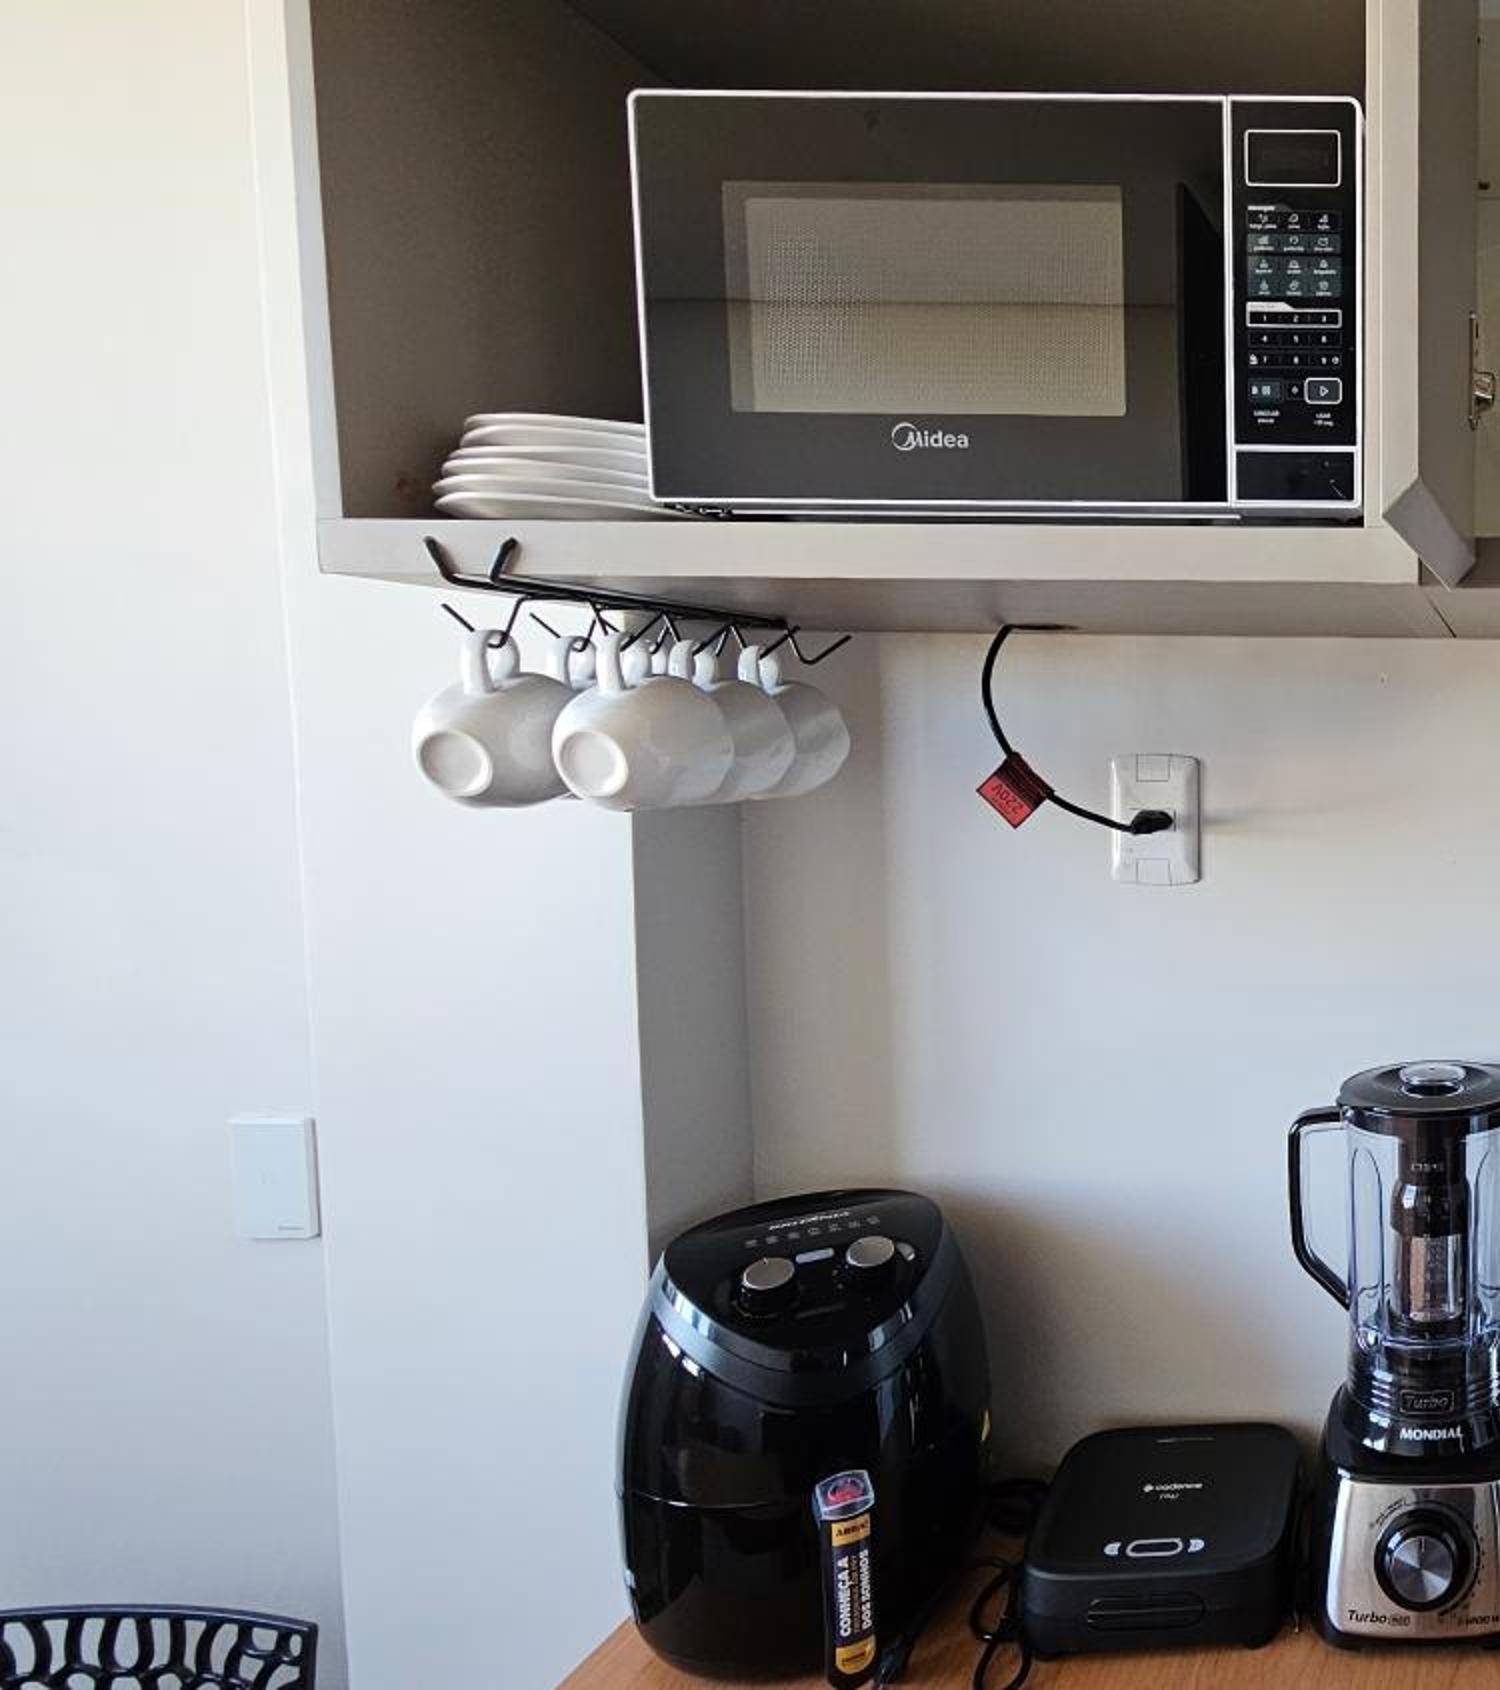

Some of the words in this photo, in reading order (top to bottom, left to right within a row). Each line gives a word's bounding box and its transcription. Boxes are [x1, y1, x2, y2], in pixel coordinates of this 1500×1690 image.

[892, 422, 969, 451] Midea
[1400, 1426, 1462, 1441] MONDIAL
[838, 1556, 849, 1568] A
[838, 1570, 853, 1637] CONHEÇA
[860, 1601, 873, 1630] DOS
[1348, 1609, 1387, 1625] Turbo
